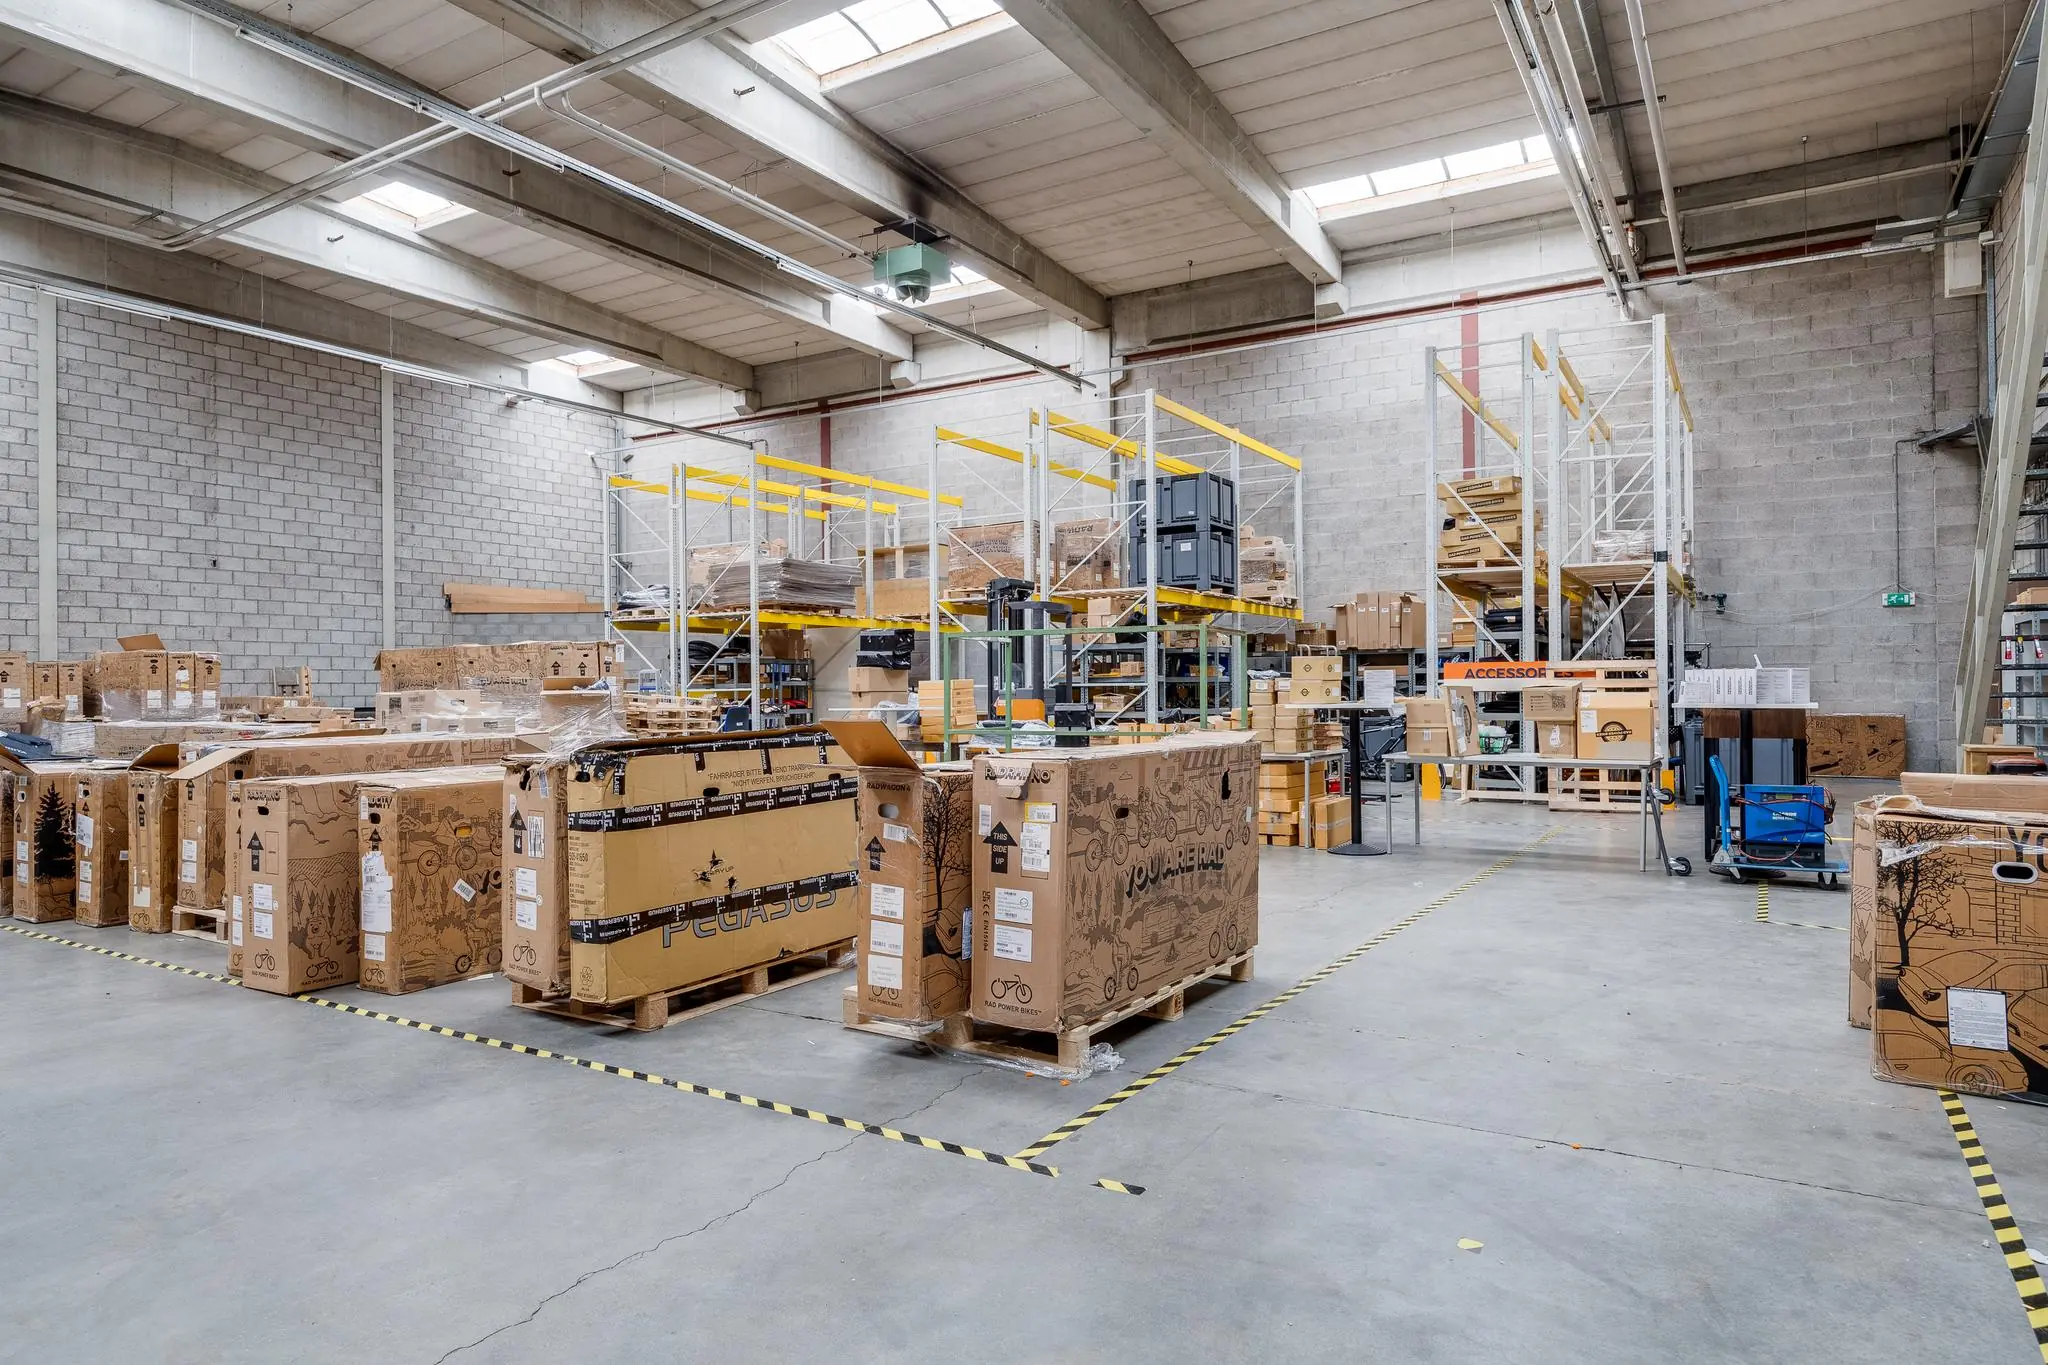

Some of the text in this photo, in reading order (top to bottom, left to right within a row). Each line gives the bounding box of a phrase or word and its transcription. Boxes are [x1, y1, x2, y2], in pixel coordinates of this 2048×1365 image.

[993, 845, 1007, 853] SIDE
[1122, 842, 1225, 898] YOU ARE RAD
[985, 1000, 996, 1008] RAD
[998, 1002, 1019, 1011] POWER
